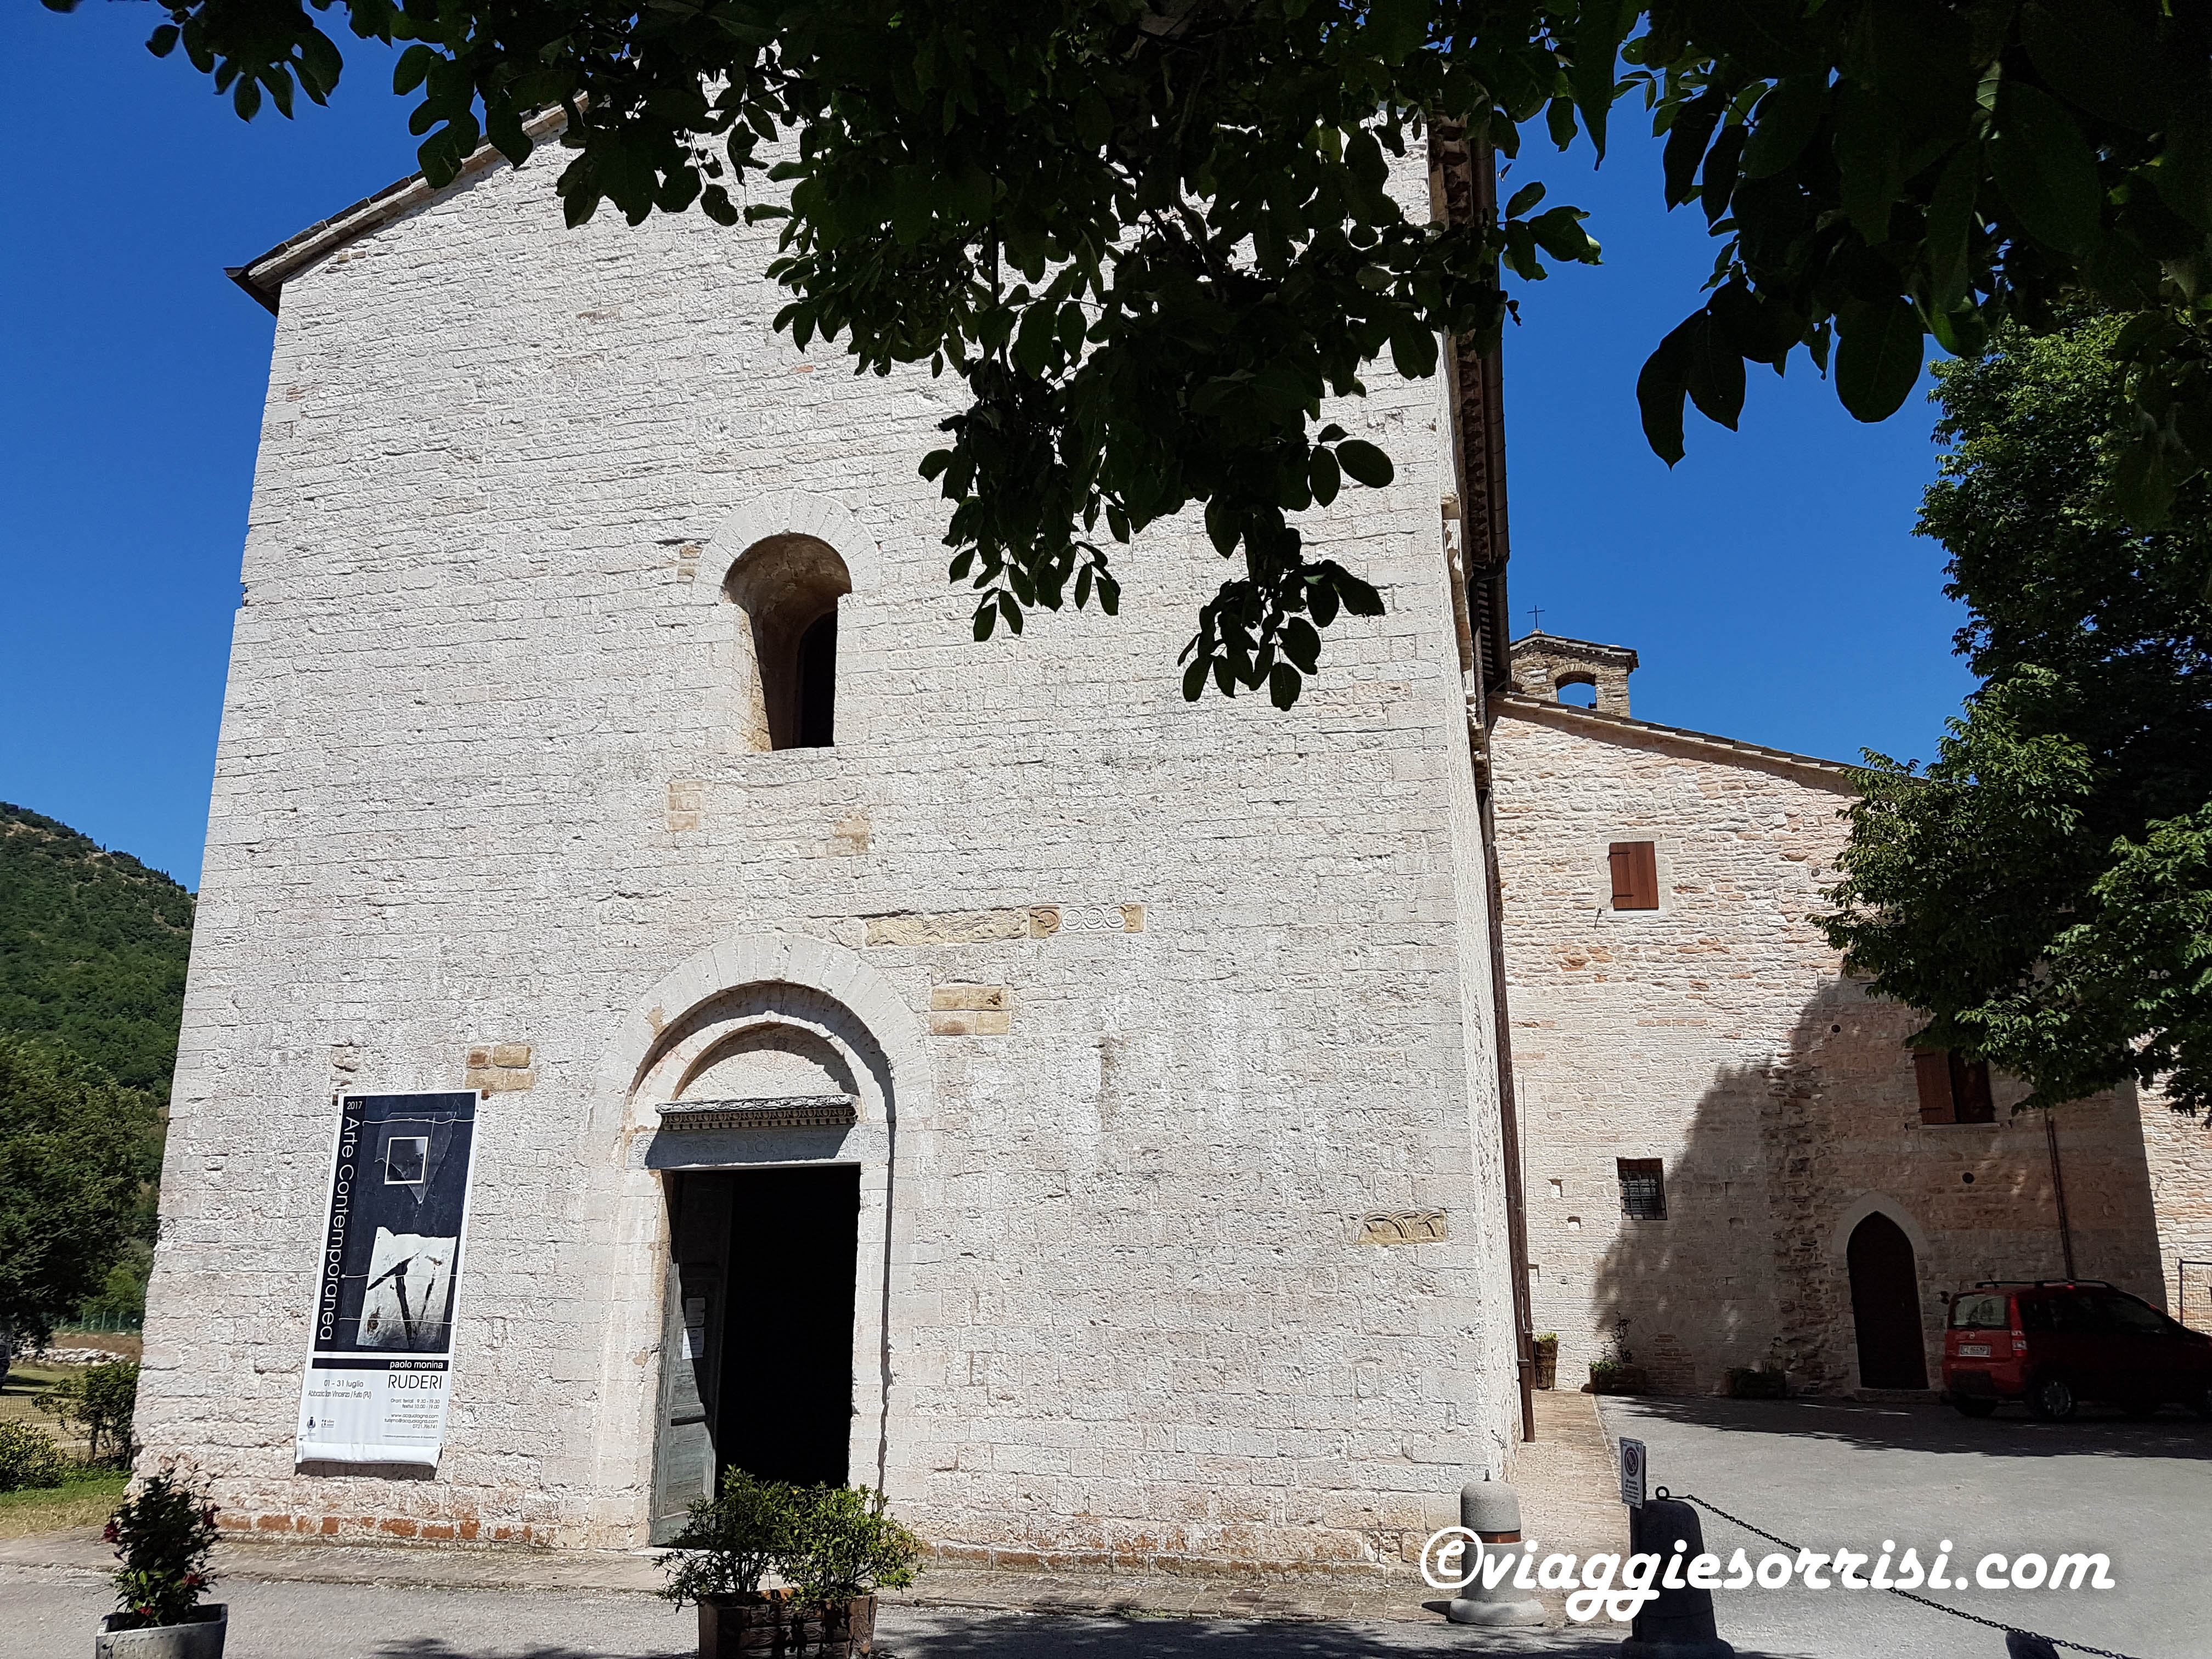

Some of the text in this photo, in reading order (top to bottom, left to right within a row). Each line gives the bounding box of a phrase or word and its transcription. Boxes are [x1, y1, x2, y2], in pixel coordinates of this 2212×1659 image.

[347, 1101, 362, 1110] 2017
[319, 1116, 360, 1340] Arte Contemporanea
[390, 1360, 443, 1369] paolo monina
[346, 1380, 364, 1389] luglio
[388, 1374, 442, 1390] RUDERI
